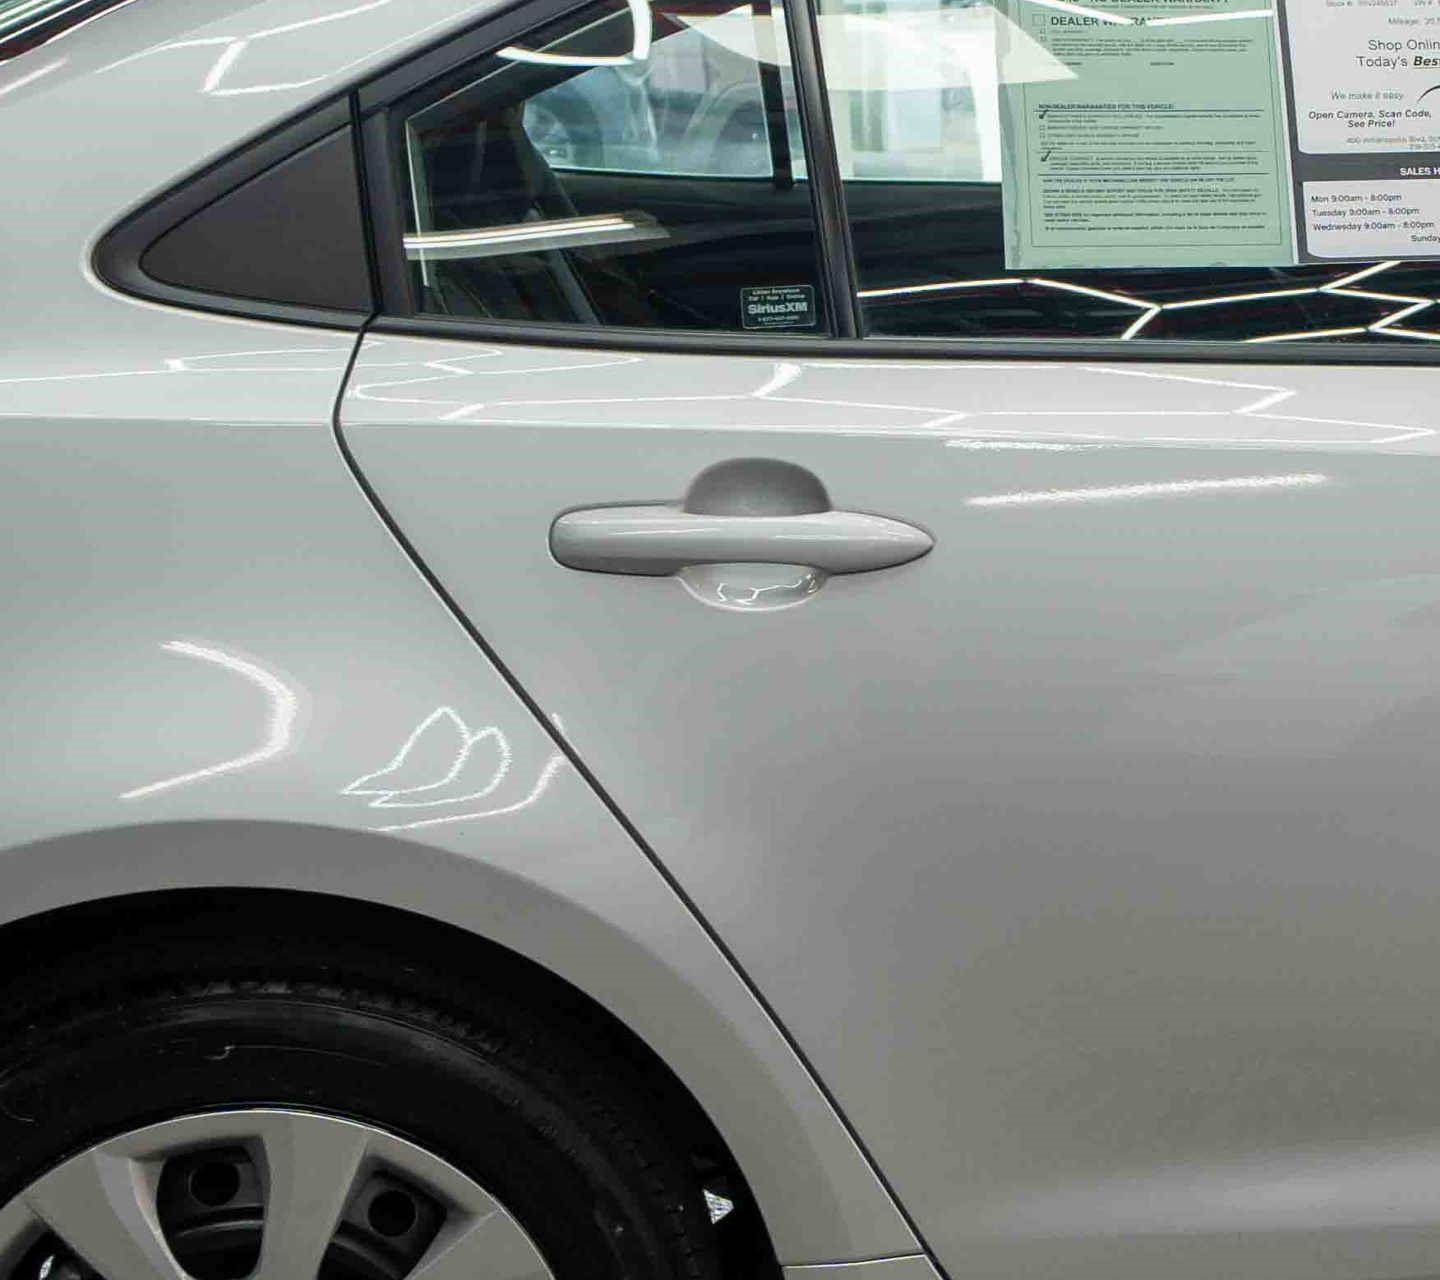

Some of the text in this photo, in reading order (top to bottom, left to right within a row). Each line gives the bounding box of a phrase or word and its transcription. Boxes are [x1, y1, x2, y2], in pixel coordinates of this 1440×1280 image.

[1051, 16, 1099, 26] DEALER
[1368, 39, 1402, 52] Shop
[1356, 56, 1408, 69] Today's
[1308, 109, 1432, 120] Open Camera, Scan Code,
[1348, 120, 1395, 128] See Price!
[1400, 167, 1431, 176] SALES
[1312, 209, 1346, 217] Tuesday
[1313, 223, 1361, 232] Wednesday
[747, 301, 808, 315] SiriusXM
